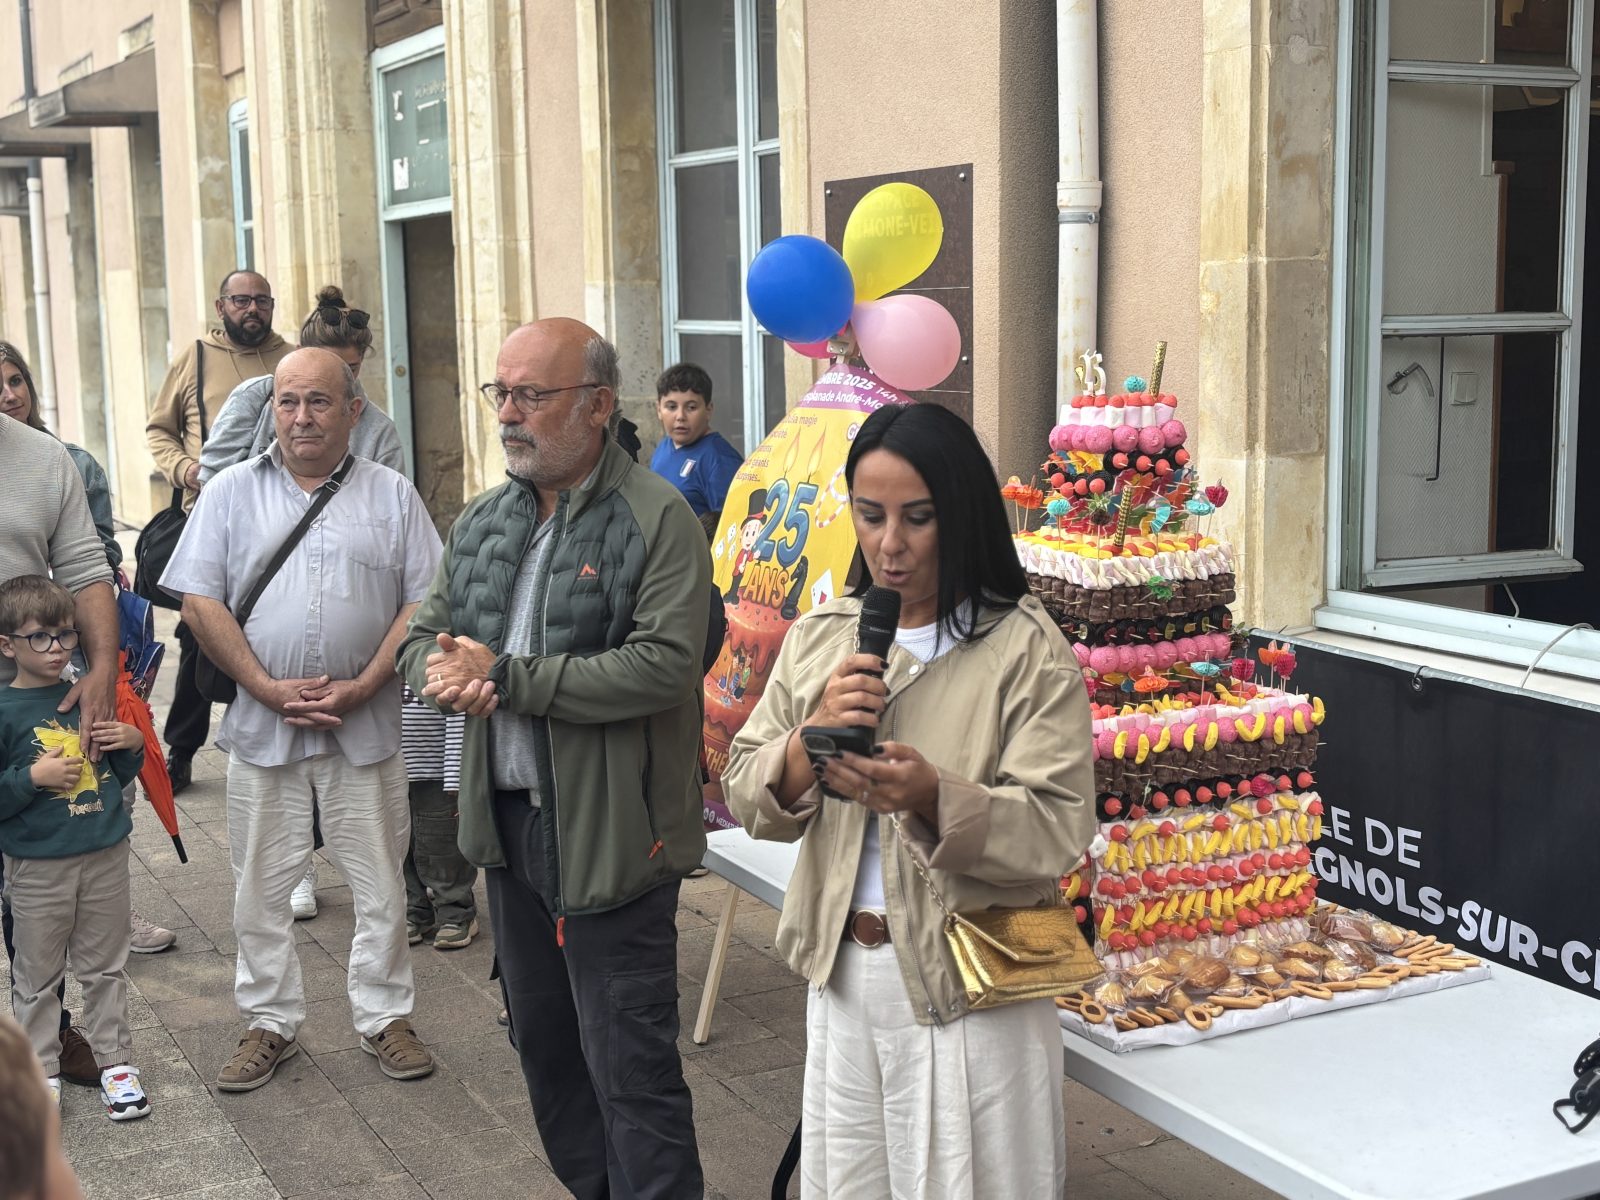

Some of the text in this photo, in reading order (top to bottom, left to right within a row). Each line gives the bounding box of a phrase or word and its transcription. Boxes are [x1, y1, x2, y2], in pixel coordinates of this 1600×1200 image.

[835, 391, 884, 410] André-Mo
[843, 373, 876, 391] 2025
[876, 386, 898, 402] 14h
[751, 478, 819, 568] 25
[742, 563, 790, 609] ANS
[1364, 816, 1422, 868] DE
